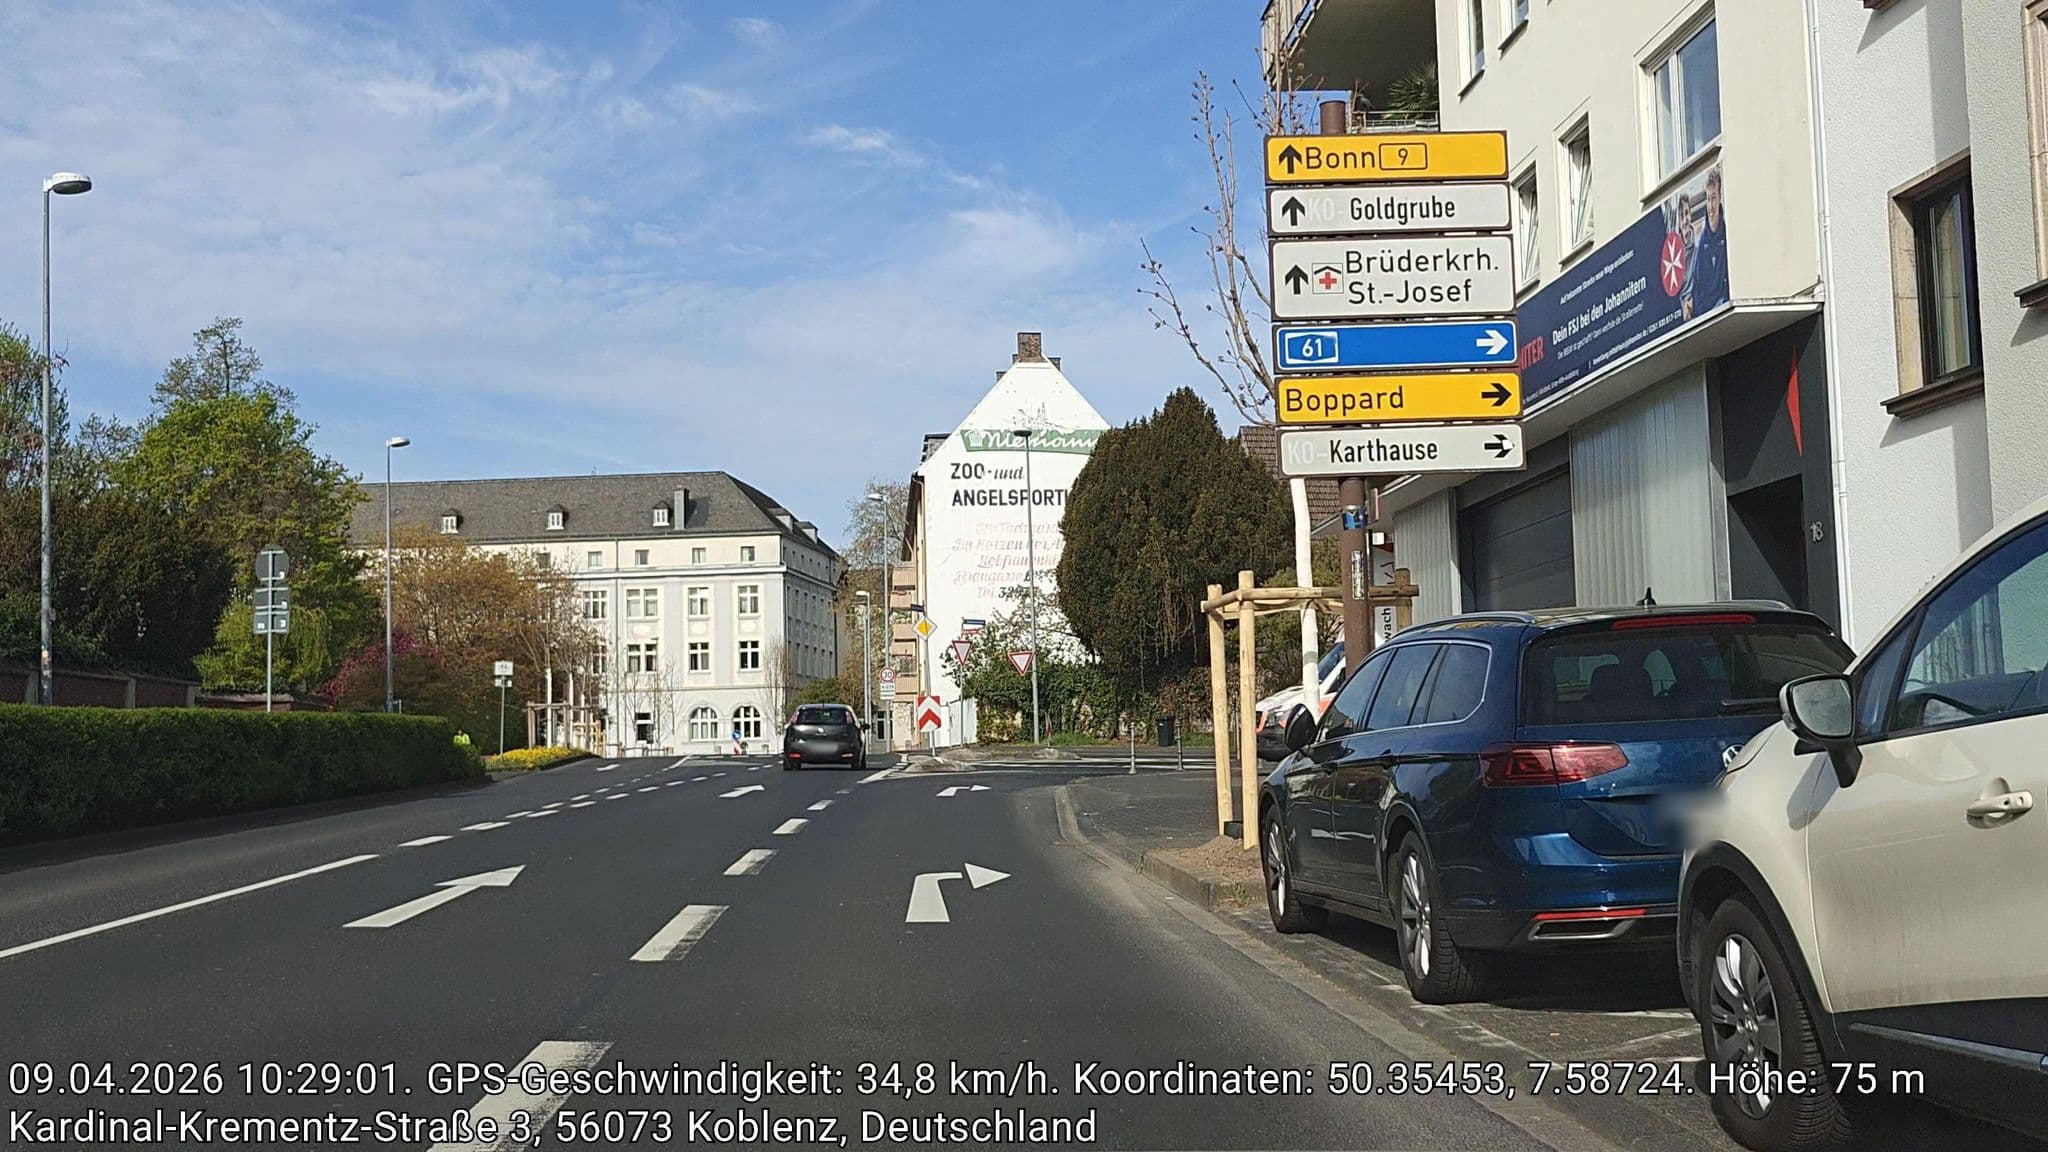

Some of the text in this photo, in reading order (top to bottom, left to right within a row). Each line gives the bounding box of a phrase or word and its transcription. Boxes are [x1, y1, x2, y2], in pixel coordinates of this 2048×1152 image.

[1305, 146, 1409, 170] Bonn 9
[1349, 194, 1456, 225] Goldgrube
[1345, 247, 1499, 274] Brüderkrh.
[1348, 278, 1472, 305] St.-Josef
[1552, 275, 1647, 346] Dein FSJ bei den Johannitern
[1301, 337, 1323, 358] 61
[1286, 384, 1404, 416] Boppard
[1329, 438, 1438, 464] Karthause
[952, 488, 1070, 507] ANGELSPORT
